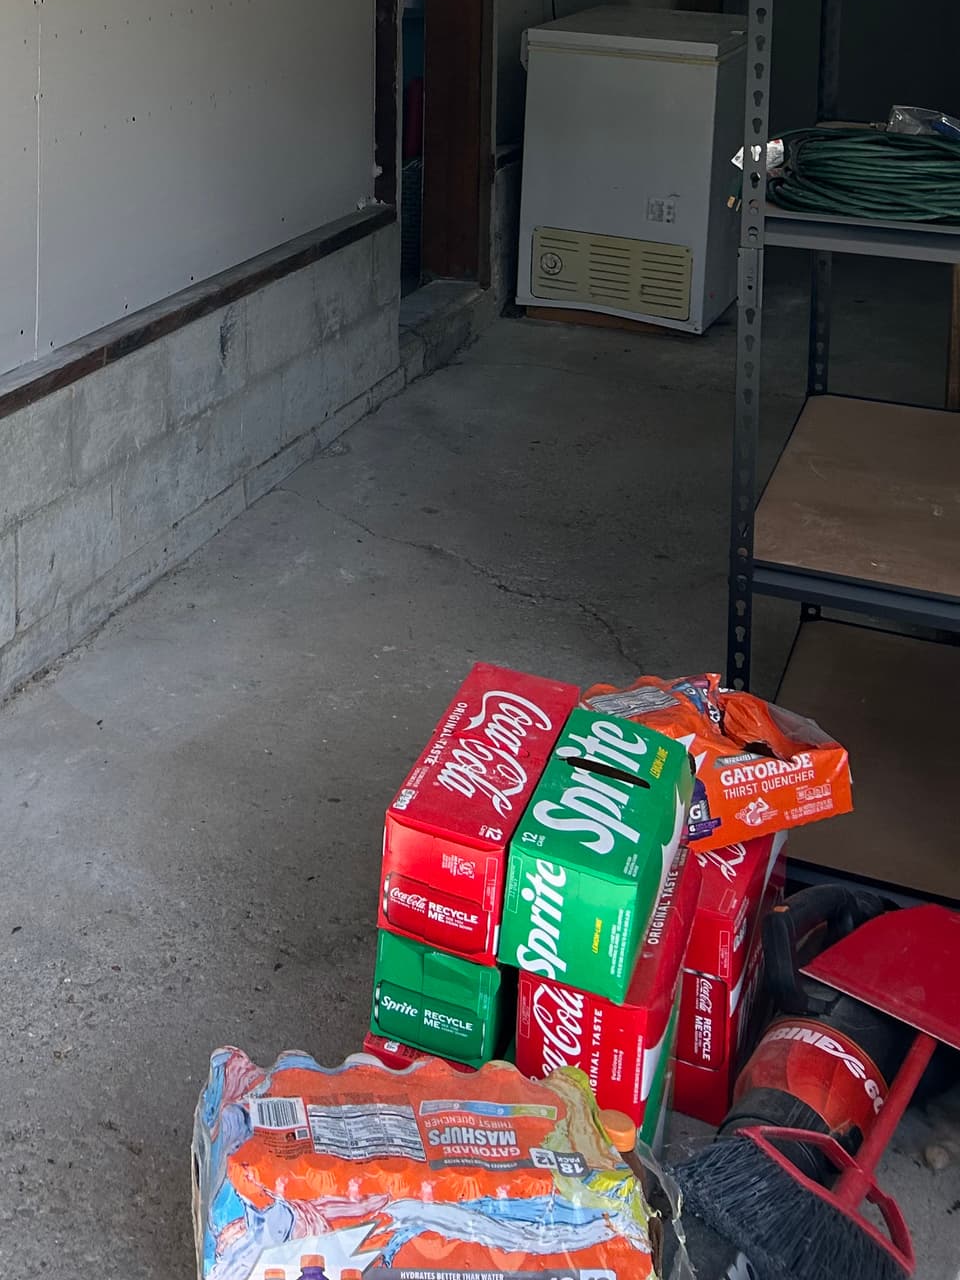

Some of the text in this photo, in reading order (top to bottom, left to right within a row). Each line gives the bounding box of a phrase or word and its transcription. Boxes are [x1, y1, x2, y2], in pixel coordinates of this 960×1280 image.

[424, 702, 468, 766] ORIGINAL TASTE
[437, 690, 553, 819] Coca-Cola
[720, 753, 813, 787] GATORADE
[533, 720, 648, 855] Sprite
[723, 780, 759, 800] THIRST
[761, 770, 815, 793] QUENCHER
[689, 804, 702, 820] G
[486, 826, 504, 841] 12
[522, 831, 539, 844] 12
[390, 887, 428, 909] Coca-Cola
[647, 895, 672, 945] ORIGINAL
[661, 871, 679, 897] TASTE
[428, 902, 479, 924] RECYCLE
[428, 911, 445, 923] ME
[516, 858, 567, 980] Sprite
[381, 995, 419, 1017] Sprite
[423, 1019, 441, 1029] ME
[424, 1009, 473, 1031] RECYCLE
[694, 1015, 701, 1031] ME
[702, 1016, 712, 1062] RECYCLE
[589, 1008, 603, 1096] IGINAL TASTE
[424, 1115, 513, 1128] THIRST QUENCHER
[427, 1126, 517, 1146] MASHUPS
[442, 1145, 521, 1157] GATORADE
[535, 1155, 555, 1166] 12
[560, 1162, 584, 1174] 18
[400, 1271, 505, 1280] HYDRATES BETTER THAN WATER
